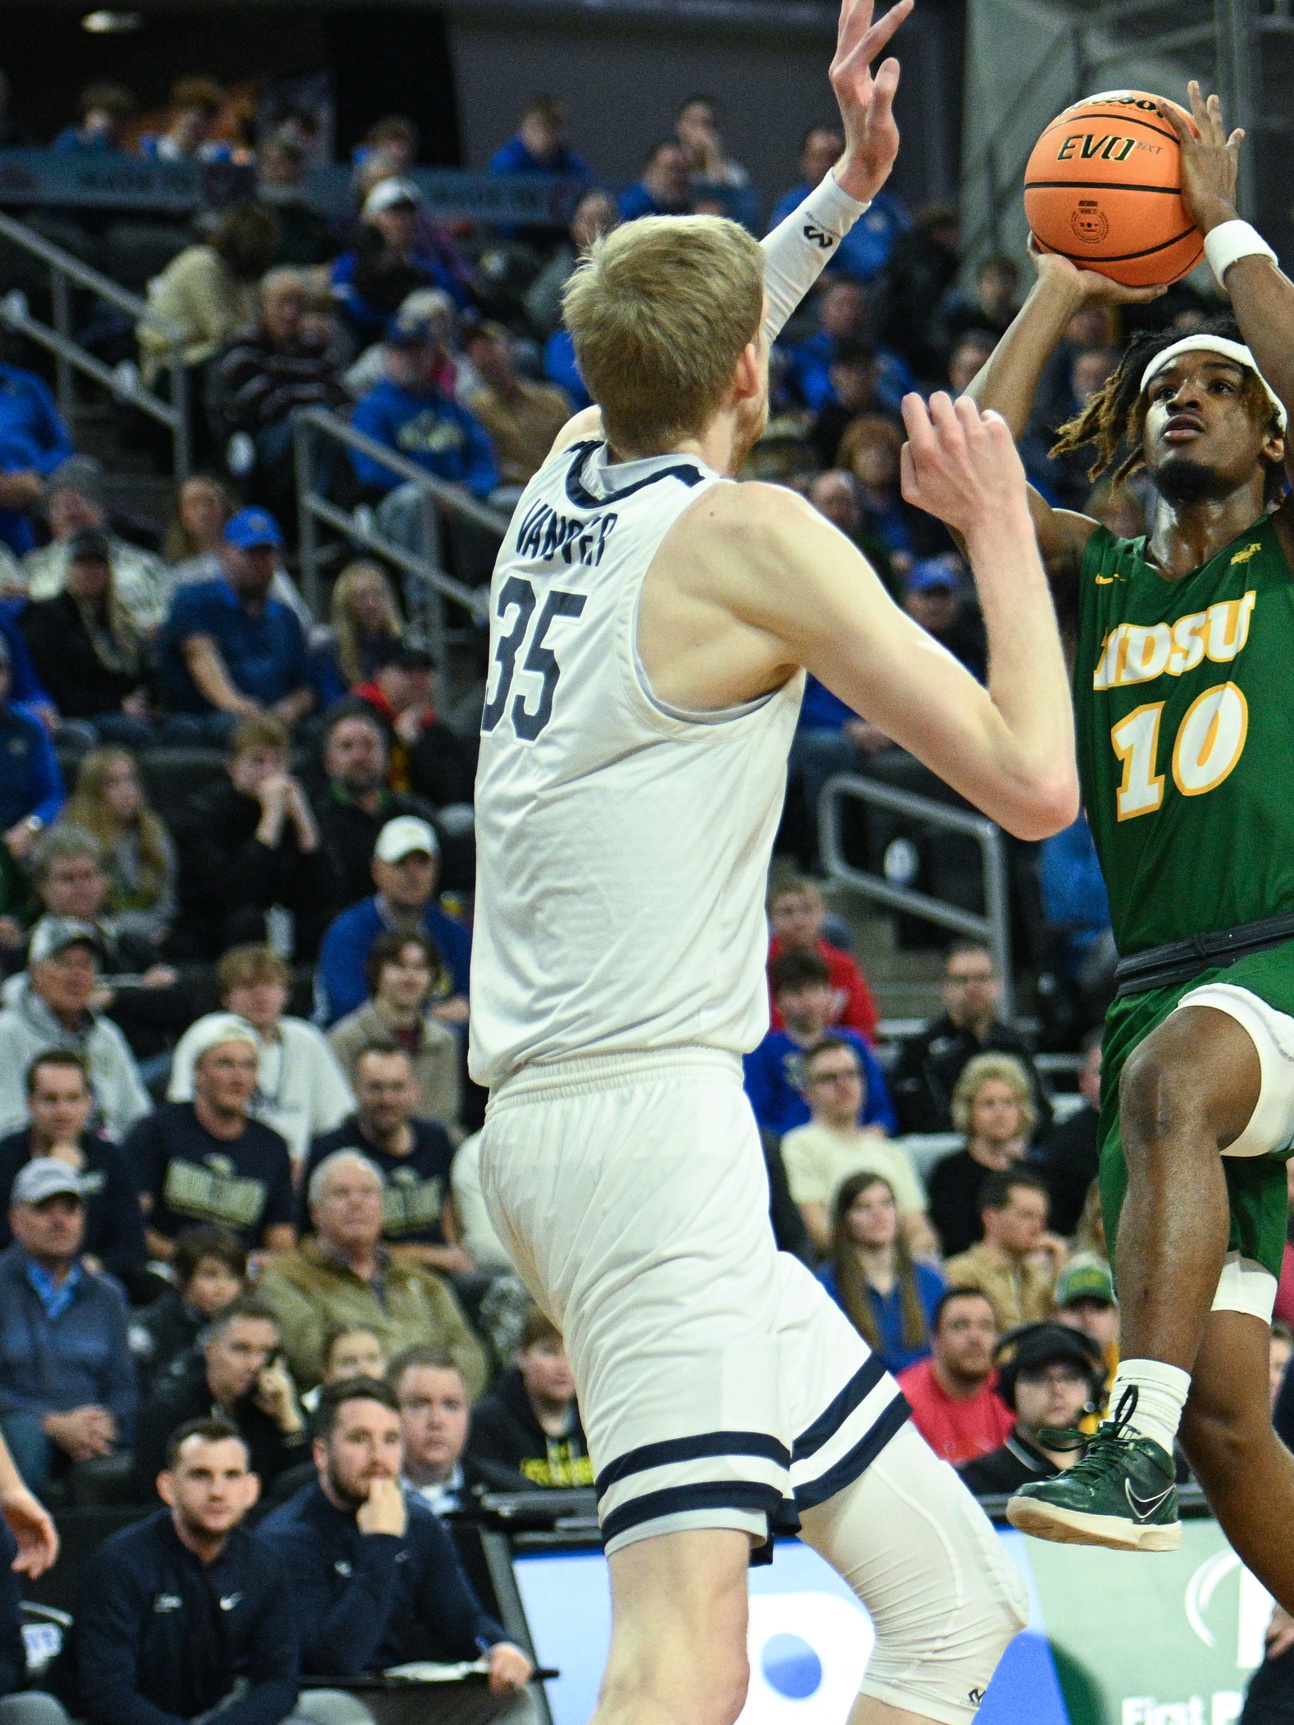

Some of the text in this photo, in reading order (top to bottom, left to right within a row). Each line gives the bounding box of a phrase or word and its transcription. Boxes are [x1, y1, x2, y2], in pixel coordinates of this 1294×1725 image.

[1056, 133, 1139, 162] EVO
[481, 575, 588, 742] 35
[1110, 681, 1248, 822] 10
